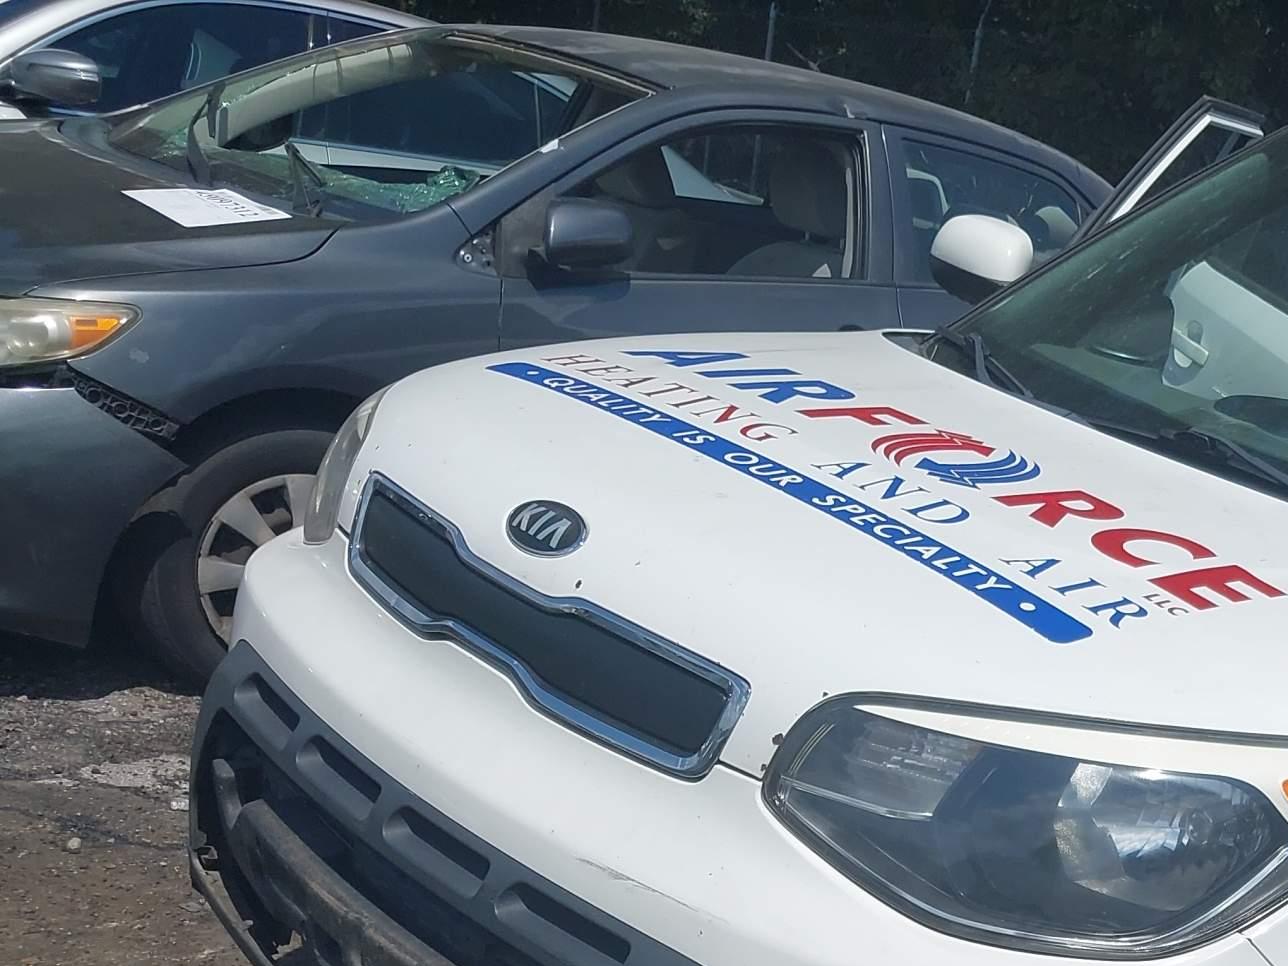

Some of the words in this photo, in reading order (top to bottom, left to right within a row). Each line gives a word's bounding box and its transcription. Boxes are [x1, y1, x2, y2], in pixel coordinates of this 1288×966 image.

[511, 502, 573, 549] KIA
[541, 353, 799, 442] HEATING
[811, 461, 970, 524] AND
[998, 557, 1149, 630] AIR
[543, 377, 671, 424] QUALITY
[672, 429, 716, 445] IS
[723, 452, 804, 488] OUR
[811, 494, 1014, 592] SPECIALTY
[1141, 593, 1190, 617] LLC
